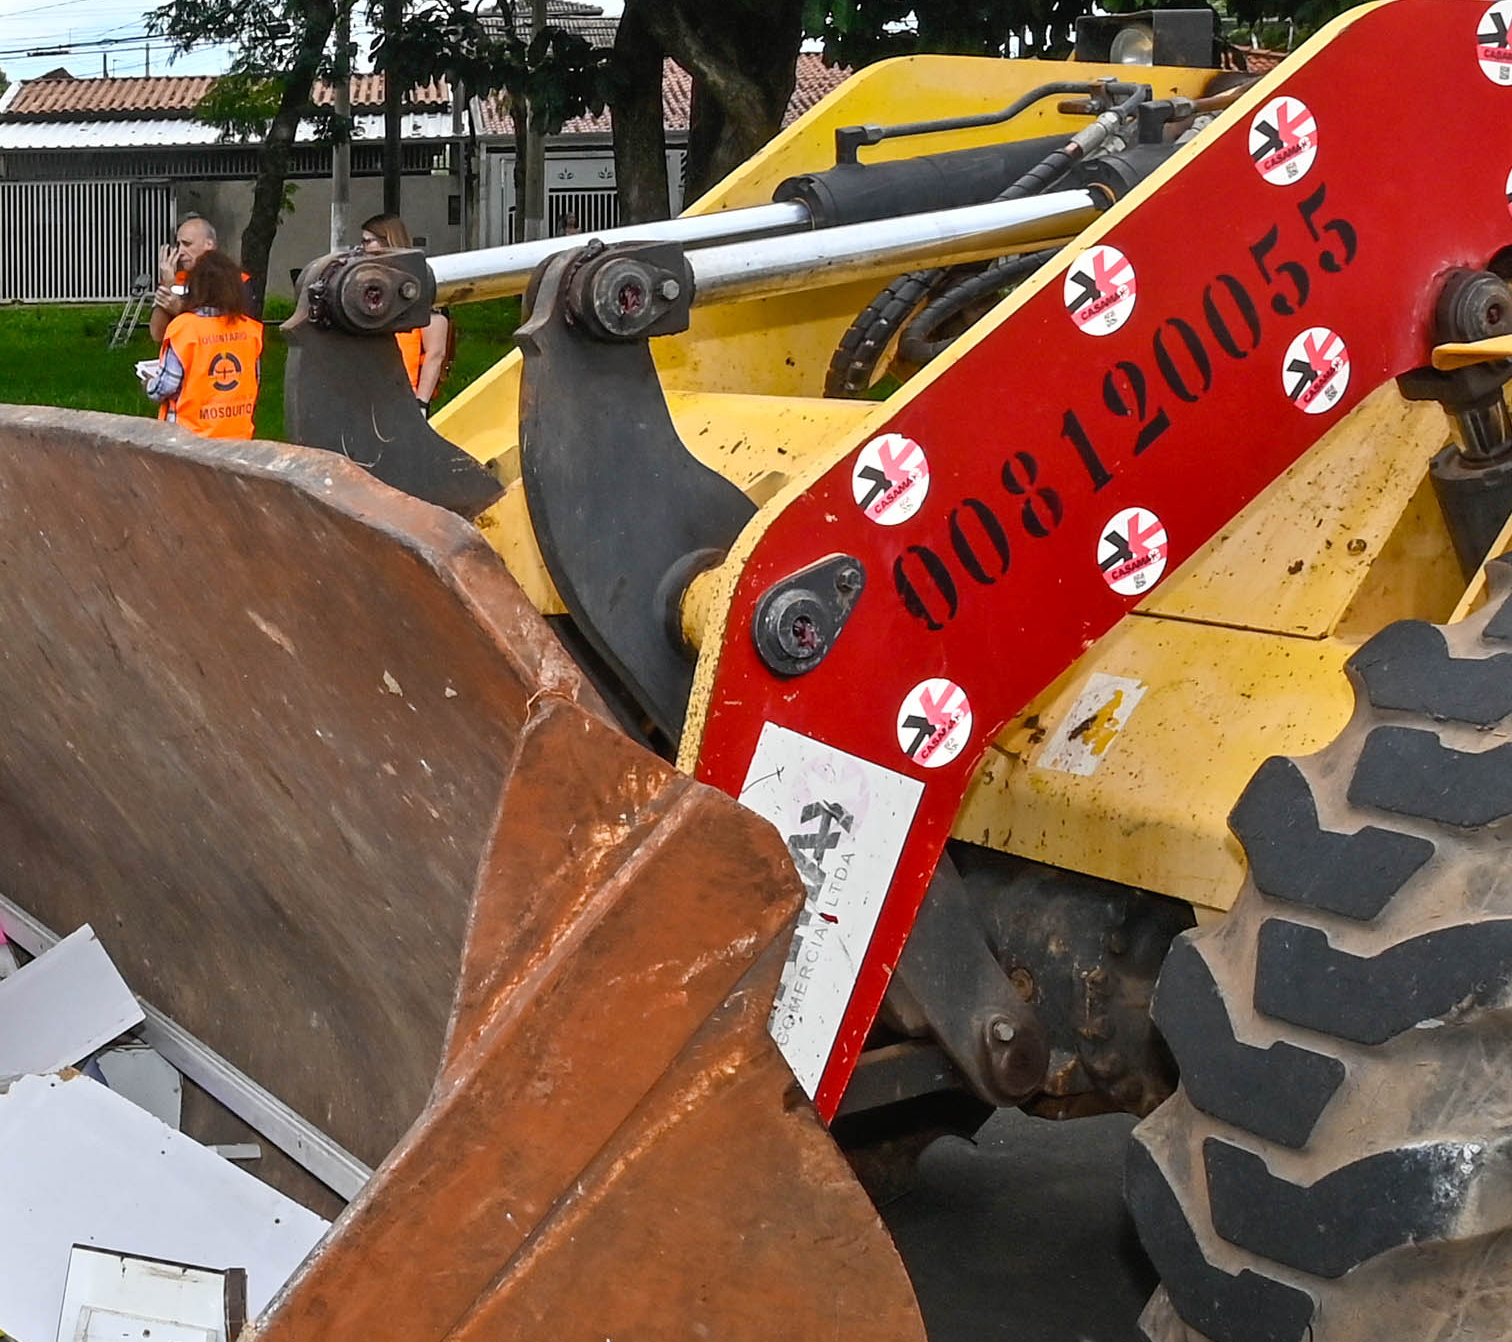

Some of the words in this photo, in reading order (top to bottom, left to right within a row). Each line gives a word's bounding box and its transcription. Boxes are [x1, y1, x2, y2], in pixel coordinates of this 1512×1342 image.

[199, 403, 253, 420] MOSQUITO
[893, 183, 1358, 631] 008120055
[825, 853, 855, 907] LTDA
